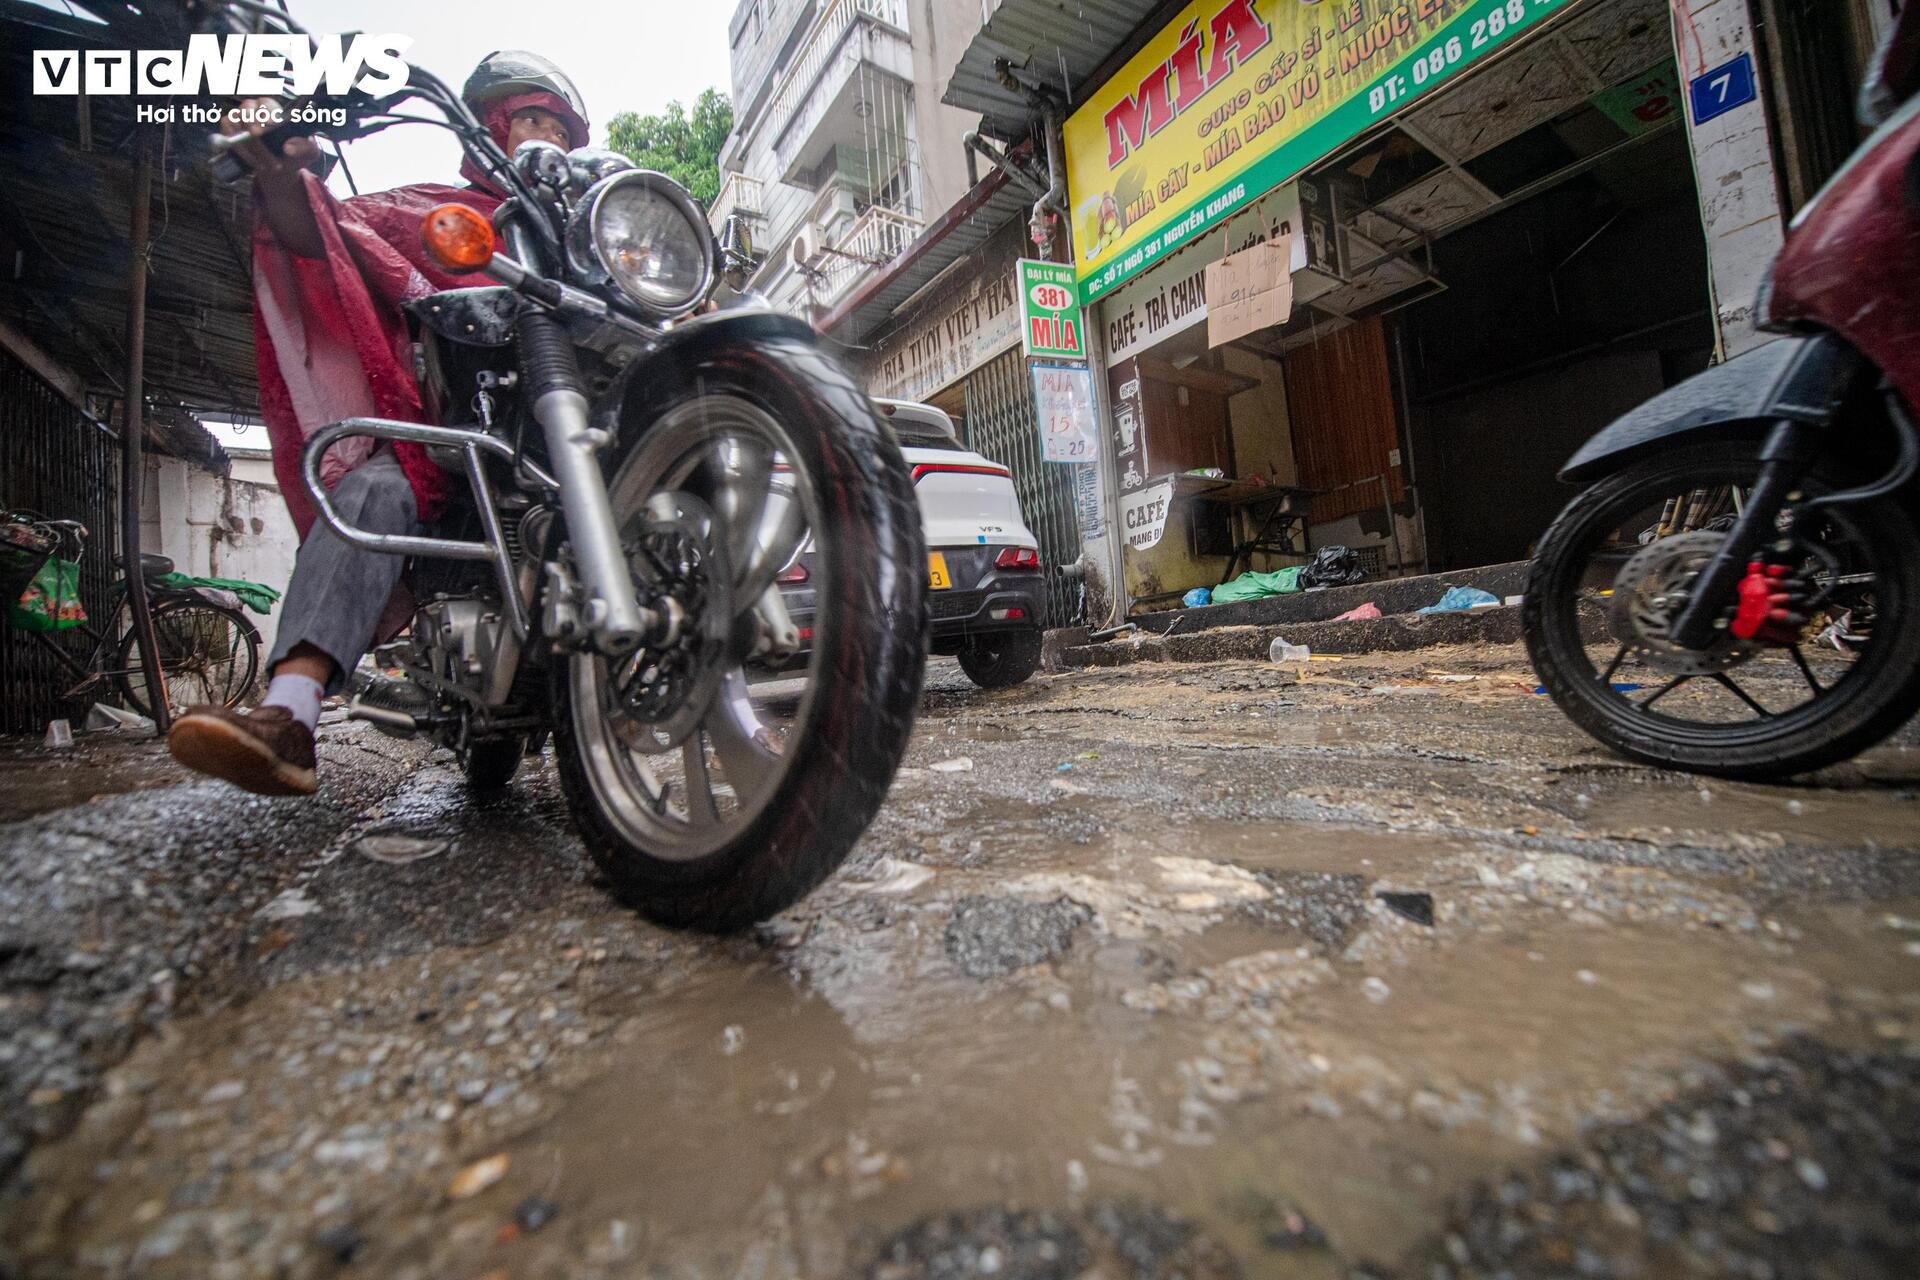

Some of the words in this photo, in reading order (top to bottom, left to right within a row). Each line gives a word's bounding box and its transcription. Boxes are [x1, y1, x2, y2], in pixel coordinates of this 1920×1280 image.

[1368, 74, 1406, 114] ĐT:
[1413, 35, 1462, 85] 086
[1470, 0, 1525, 50] 288
[1103, 0, 1272, 170] MÍA
[1198, 88, 1250, 138] CUNG
[1254, 51, 1298, 95] CẤP
[1709, 72, 1732, 104] 7
[1125, 190, 1155, 225] MÍA
[1203, 128, 1242, 171] MÍA
[1288, 64, 1319, 109] VỎ
[1339, 6, 1410, 75] NƯỚC
[1104, 265, 1116, 285] SỐ
[1117, 264, 1123, 277] 7
[1124, 252, 1144, 273] NGÕ
[1145, 240, 1162, 260] 381
[1206, 183, 1246, 219] KHANG
[1027, 268, 1042, 281] ĐẠI
[1043, 269, 1054, 281] LÝ
[1056, 271, 1073, 284] MÍA
[1037, 287, 1067, 307] 381
[1030, 312, 1079, 351] MÍA
[1110, 304, 1137, 354] CAFÉ
[1145, 286, 1169, 334] TRÀ
[1126, 495, 1165, 529] CAFÉ
[1129, 531, 1152, 546] MANG
